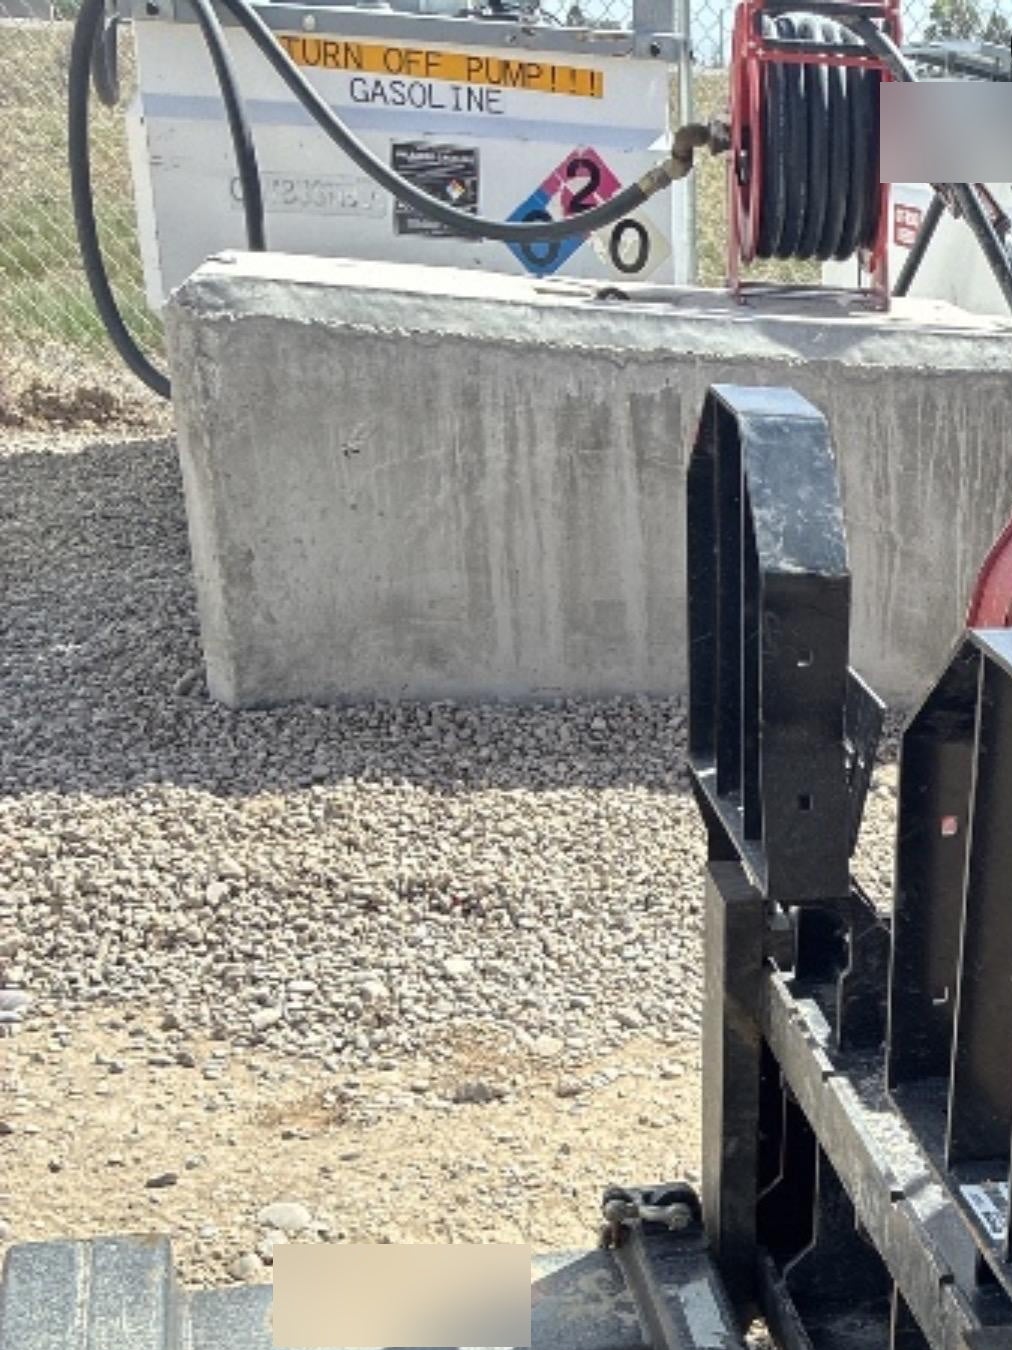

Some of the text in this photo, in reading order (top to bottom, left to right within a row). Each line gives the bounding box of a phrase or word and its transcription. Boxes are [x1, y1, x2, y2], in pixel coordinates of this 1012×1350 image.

[281, 35, 597, 98] TURN OFF PUMP!!!
[350, 76, 504, 116] GASOLINE
[566, 158, 601, 213] 2
[609, 218, 649, 274] 0
